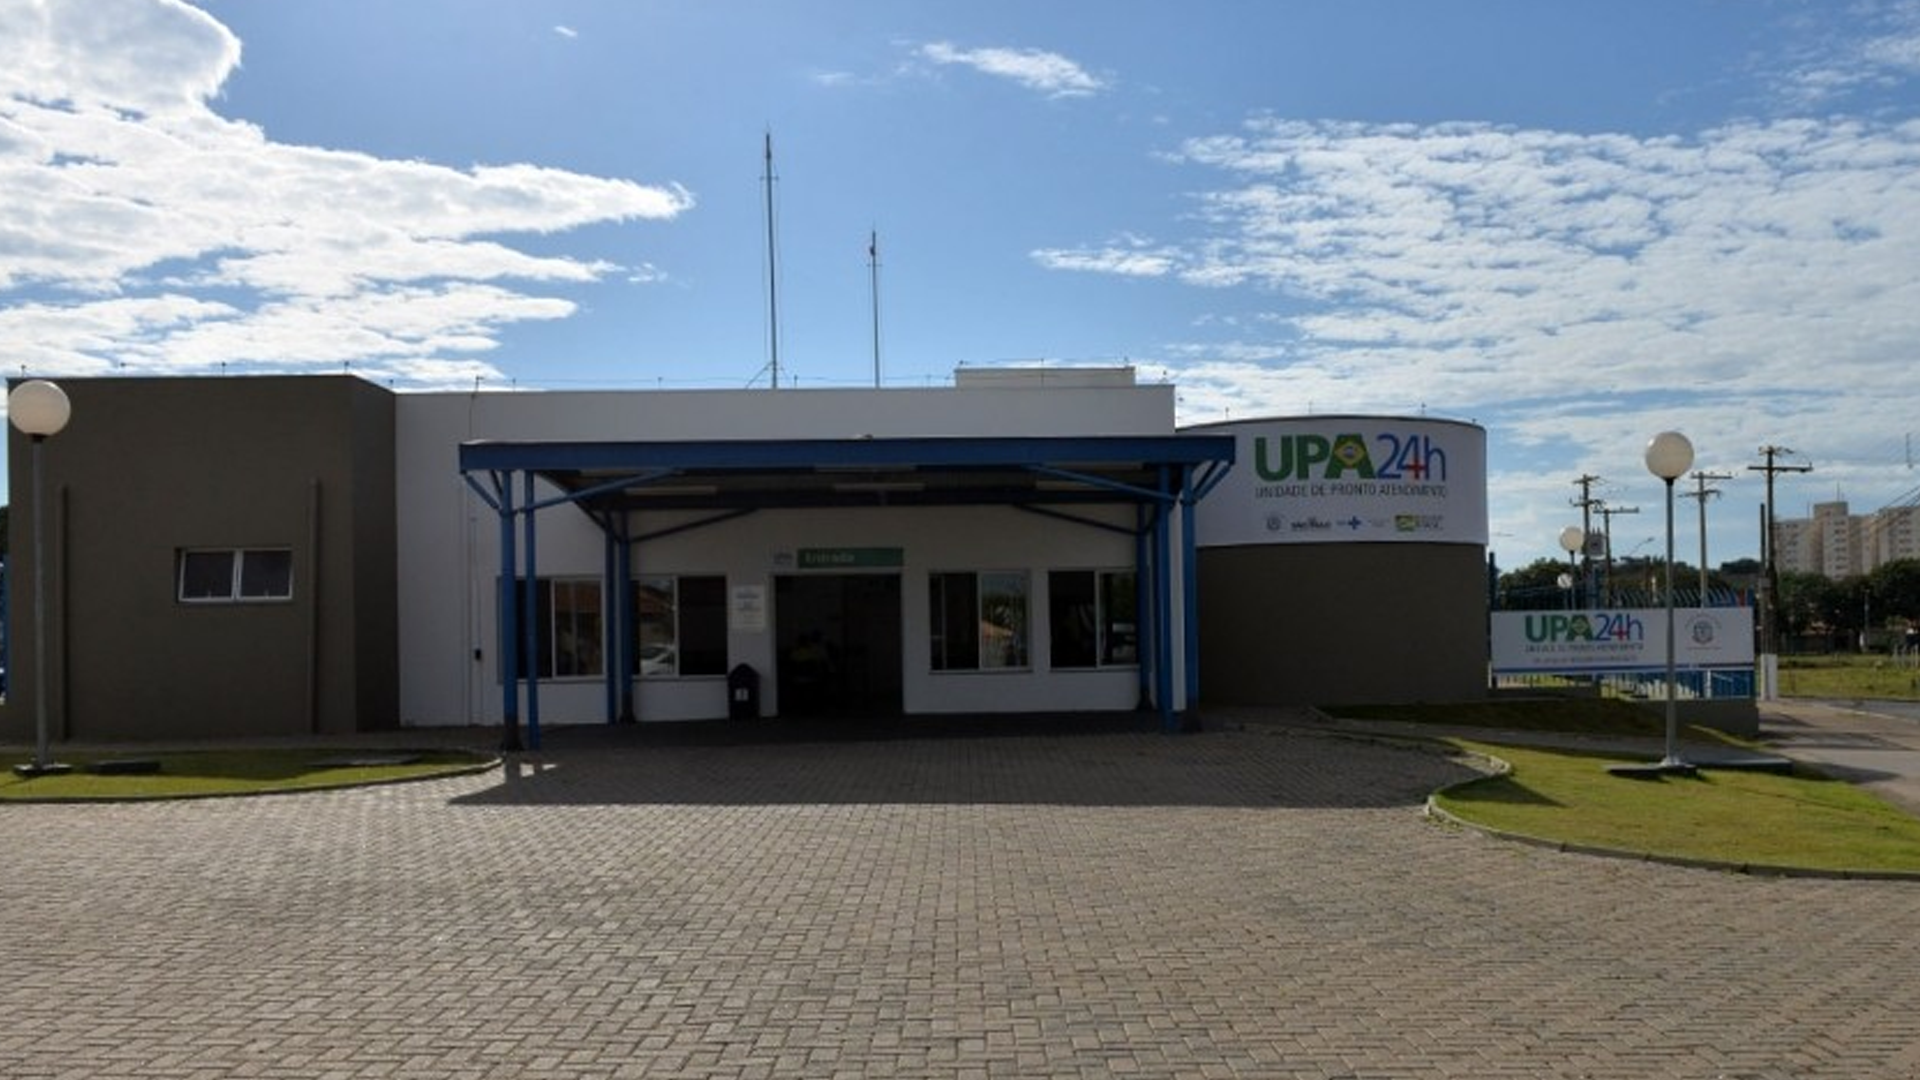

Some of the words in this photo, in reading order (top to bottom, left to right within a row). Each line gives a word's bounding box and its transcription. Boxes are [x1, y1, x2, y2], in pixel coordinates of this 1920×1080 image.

[1255, 486, 1308, 498] UNIDADE
[1310, 485, 1325, 496] DE
[1331, 483, 1376, 496] PRONTO
